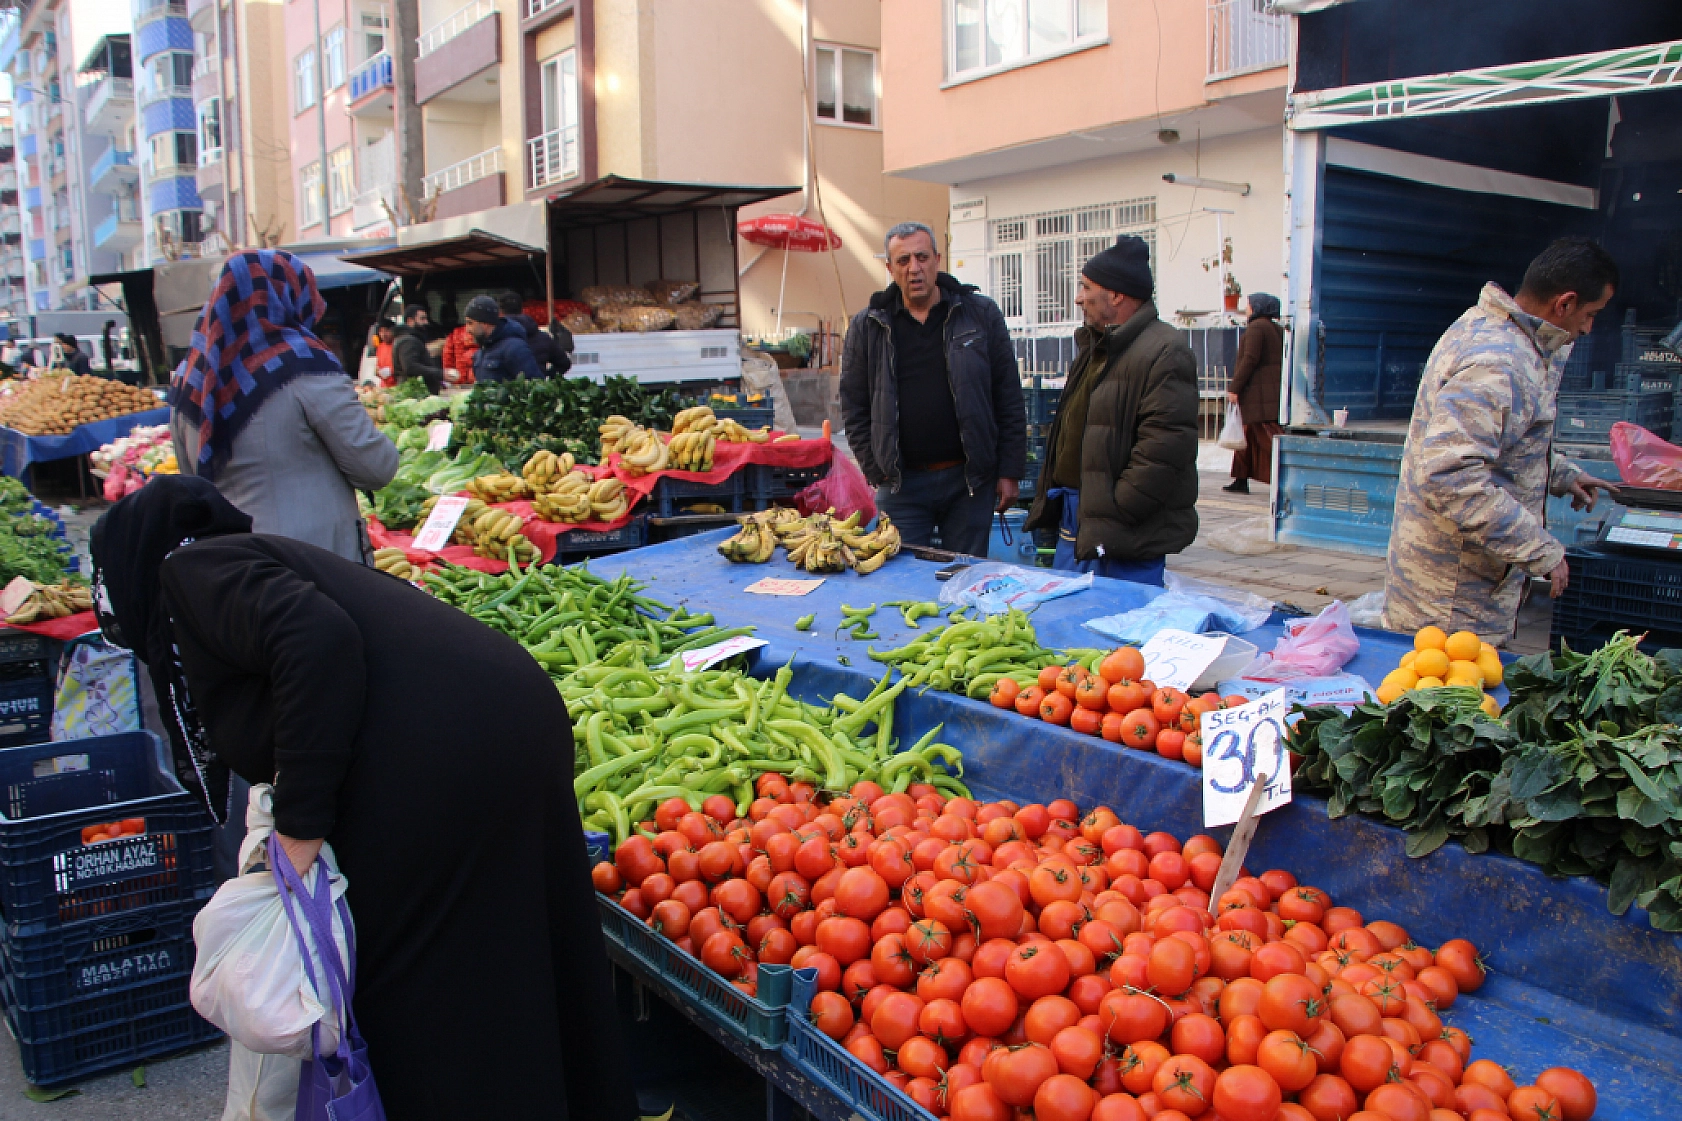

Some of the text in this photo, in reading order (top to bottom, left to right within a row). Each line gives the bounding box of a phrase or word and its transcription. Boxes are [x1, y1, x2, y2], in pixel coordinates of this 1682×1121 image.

[1206, 716, 1284, 794] 30
[76, 841, 156, 870] ORHAN AYAZ
[81, 950, 170, 979] MALATYA
